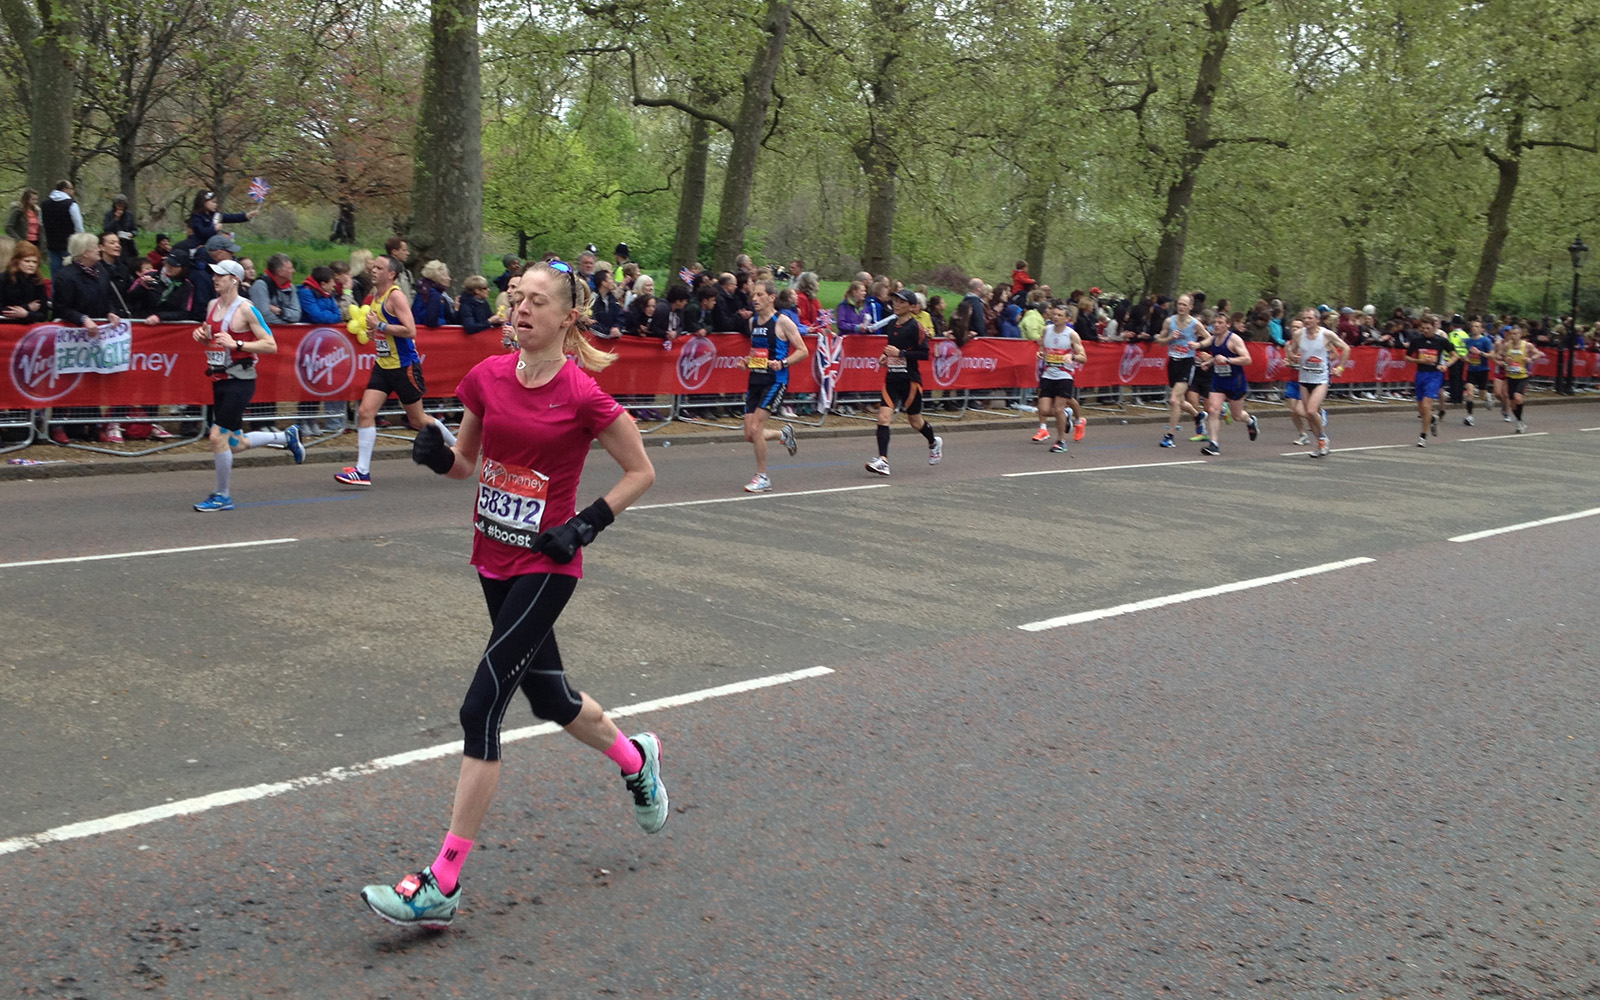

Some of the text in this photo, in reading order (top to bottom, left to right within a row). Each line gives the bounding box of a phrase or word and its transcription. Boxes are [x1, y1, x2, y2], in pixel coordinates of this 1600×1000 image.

[19, 335, 179, 389] Virg ney
[302, 336, 350, 386] Virgin
[680, 343, 714, 381] Virgin
[843, 356, 880, 373] money
[960, 356, 998, 372] money
[508, 473, 545, 492] money
[480, 486, 541, 526] 58312
